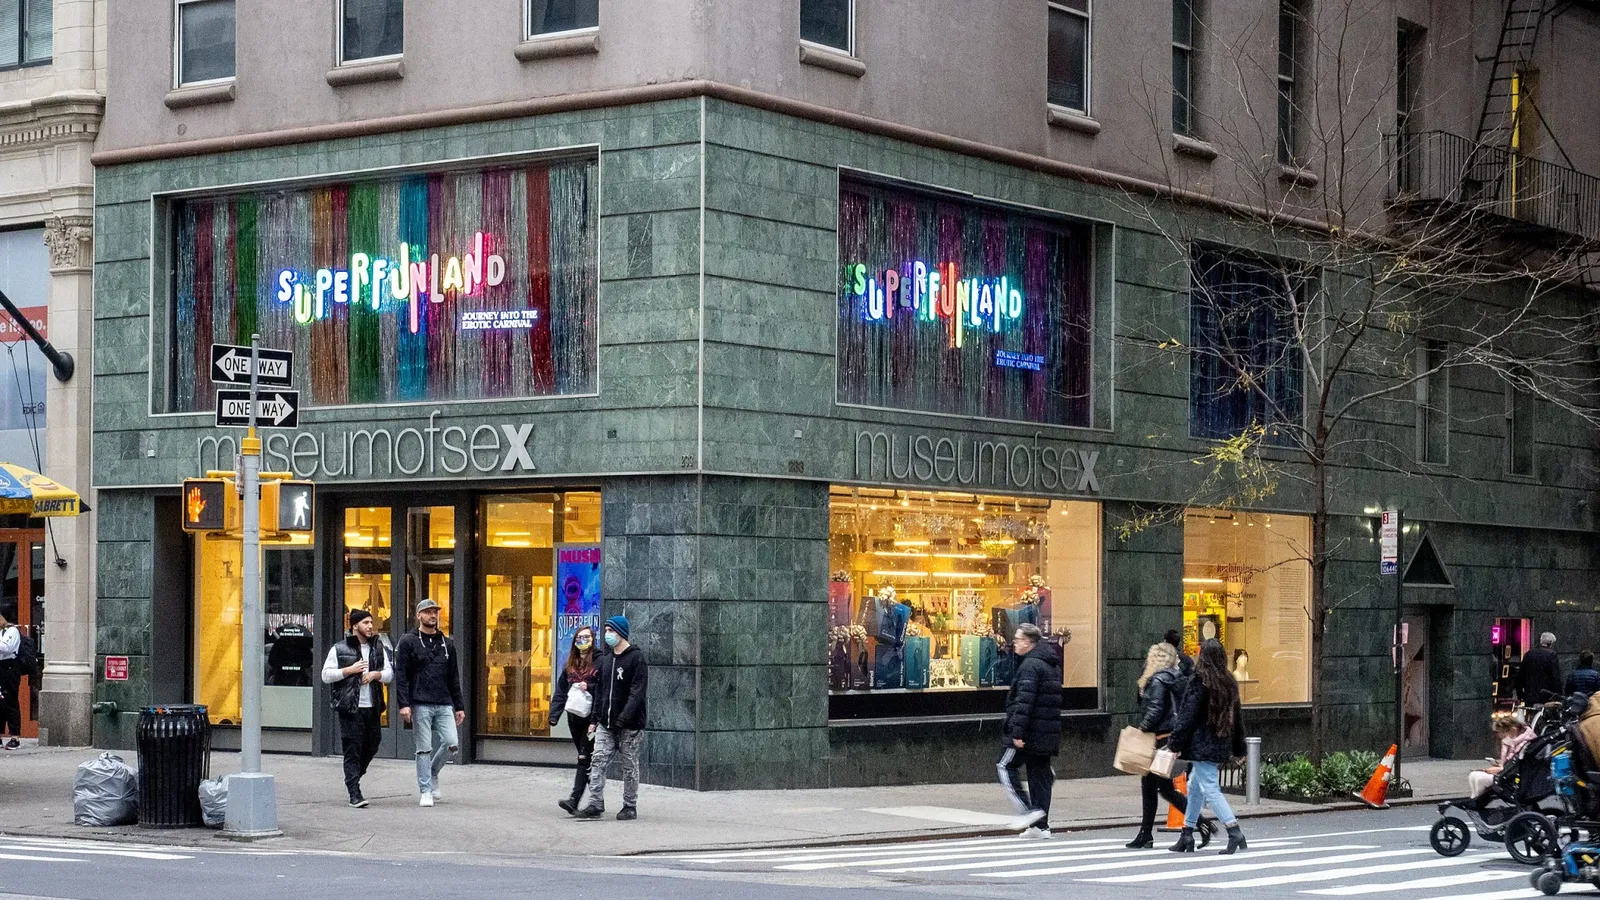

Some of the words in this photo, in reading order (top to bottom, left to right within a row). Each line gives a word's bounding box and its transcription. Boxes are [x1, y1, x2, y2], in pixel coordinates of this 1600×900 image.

[277, 231, 505, 334] SUPERFUNLAND
[853, 261, 1022, 349] SUPERFUNLAND
[462, 312, 498, 320] JOURNEY
[500, 311, 520, 319] INTO
[521, 310, 537, 319] THE
[462, 320, 492, 329] EROTIC
[493, 319, 532, 328] CARNIVAL
[224, 357, 248, 372] ONE
[258, 360, 282, 375] WAY
[228, 402, 251, 416] ONE
[262, 403, 286, 417] WAY
[855, 431, 1100, 492] museumofsex
